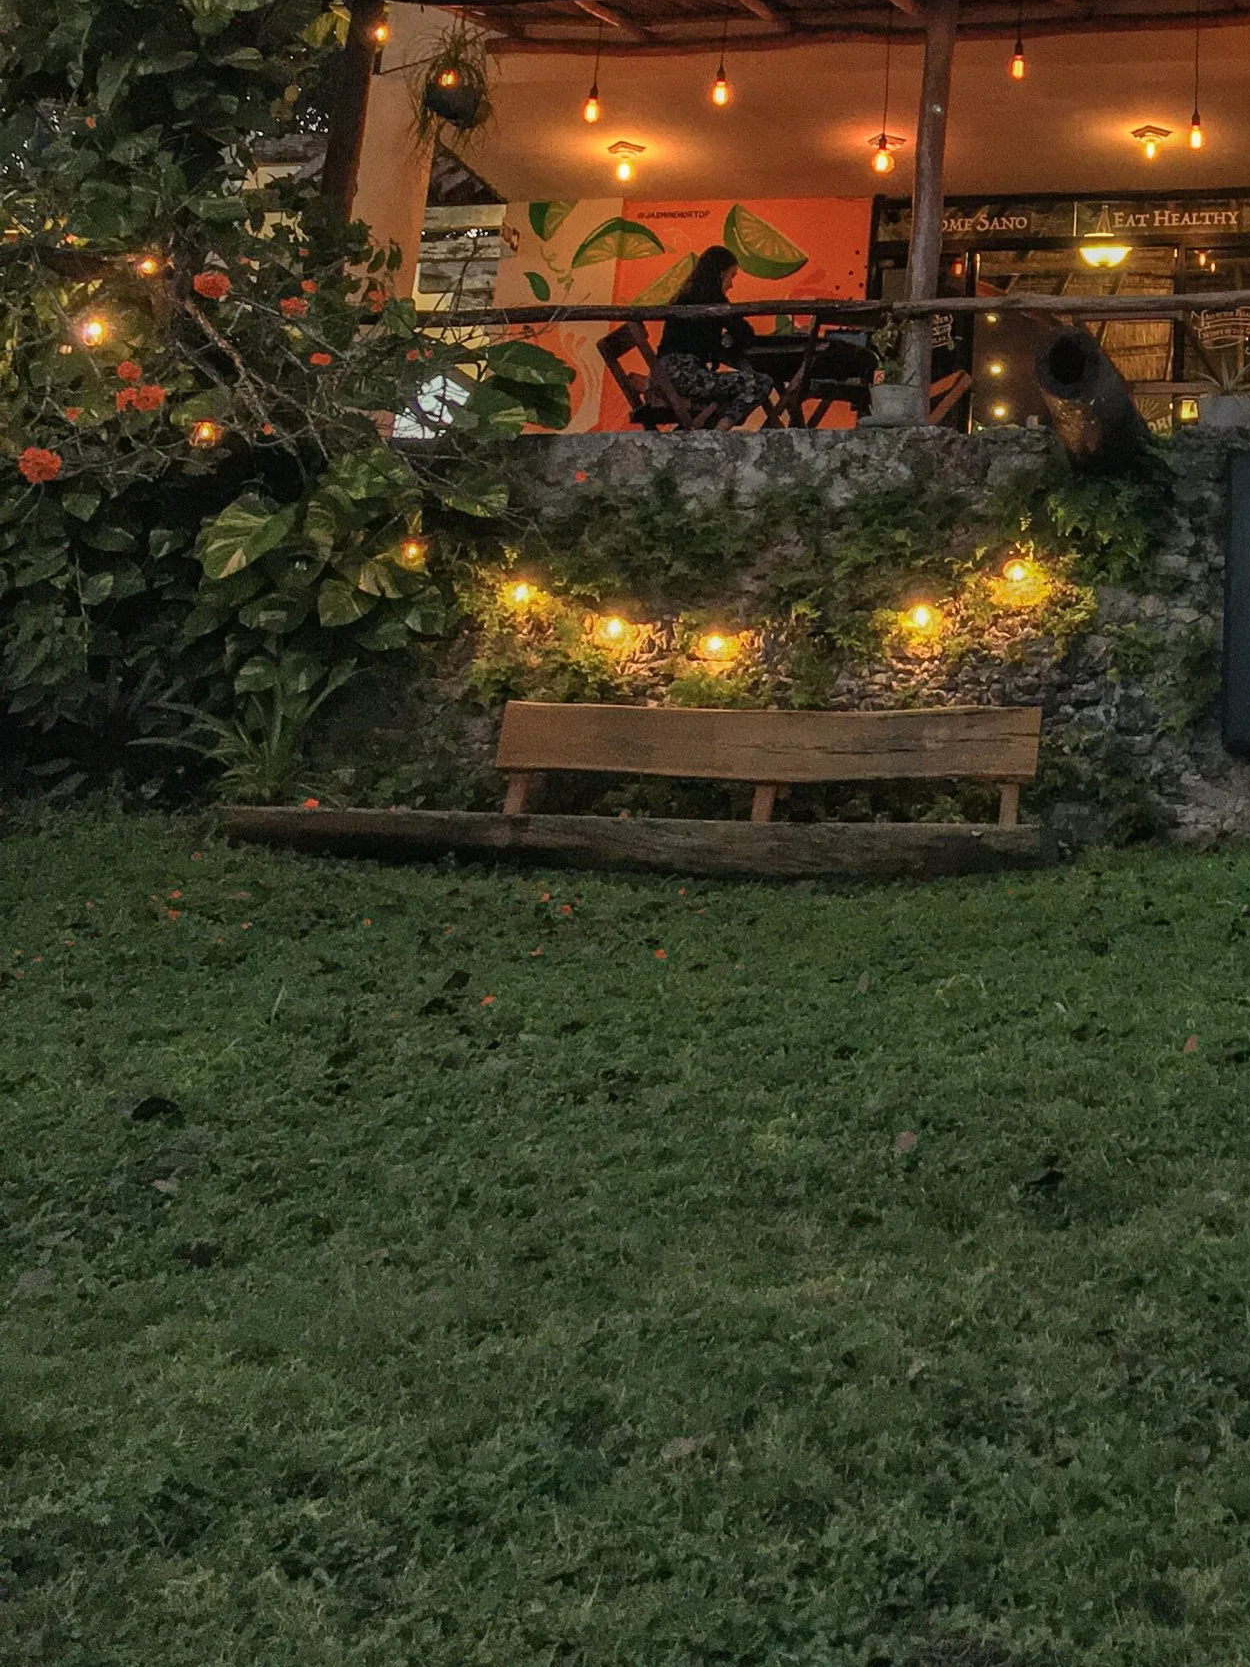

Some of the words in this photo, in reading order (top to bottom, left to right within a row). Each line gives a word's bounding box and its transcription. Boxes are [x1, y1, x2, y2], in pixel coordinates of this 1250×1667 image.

[976, 214, 1028, 232] SANO
[1112, 212, 1149, 228] EAT
[1153, 210, 1239, 227] HEALTHY
